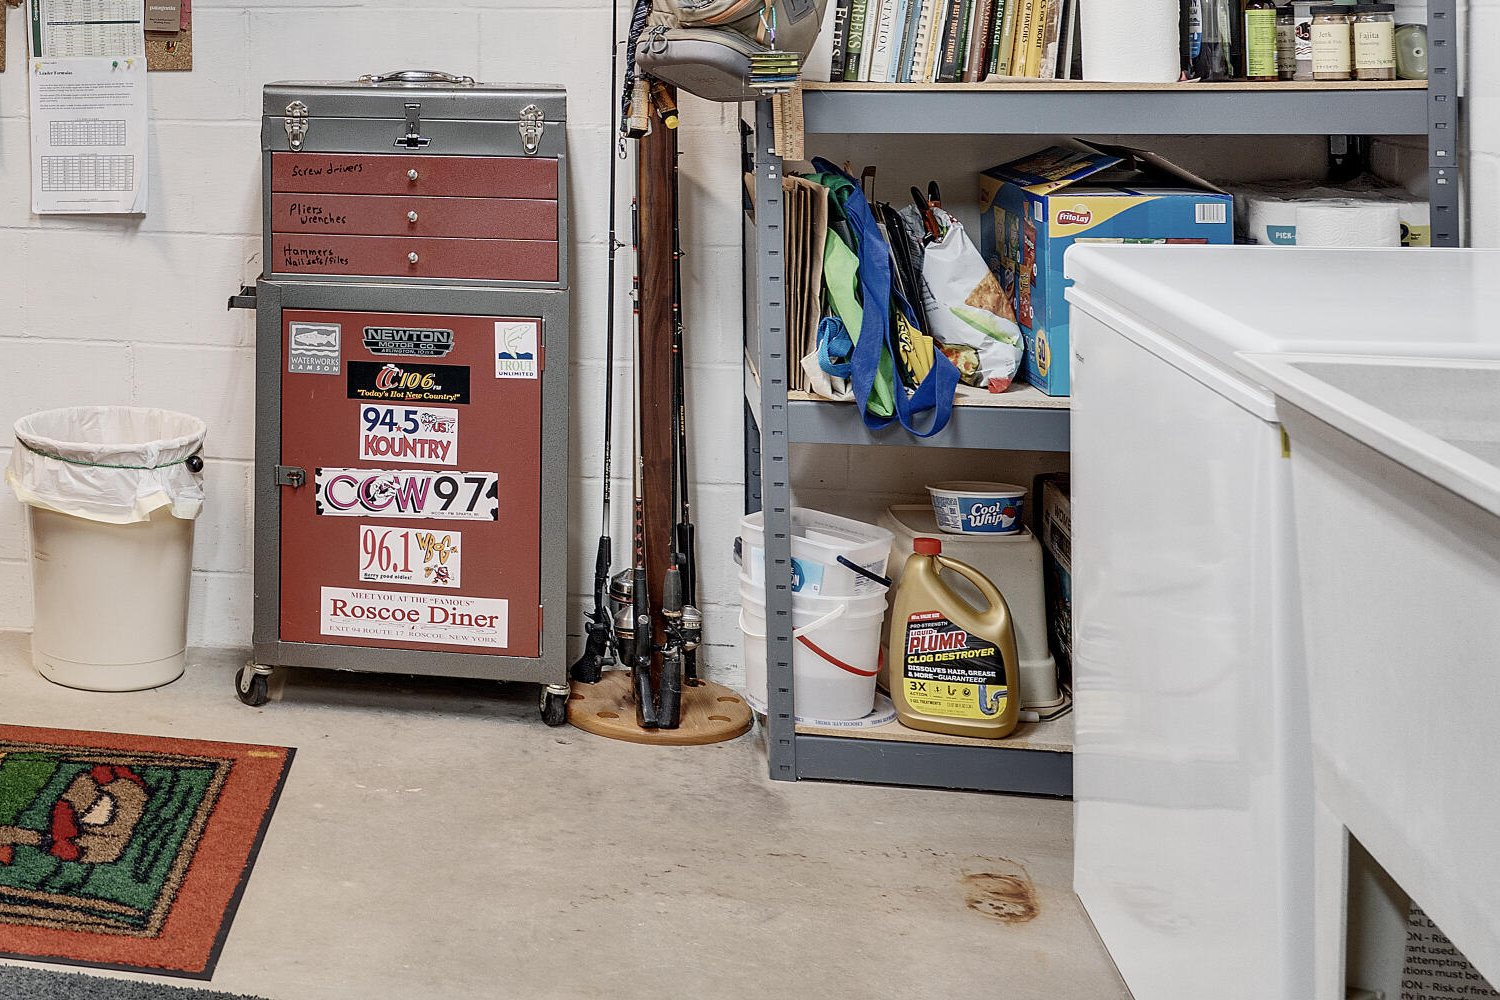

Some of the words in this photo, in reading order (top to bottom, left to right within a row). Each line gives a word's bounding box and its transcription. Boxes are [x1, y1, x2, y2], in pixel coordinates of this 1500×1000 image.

[952, 4, 961, 18] BEST
[997, 7, 1004, 18] TO
[1025, 2, 1032, 11] OF
[831, 6, 848, 57] FLIES
[949, 19, 959, 37] TROUT
[993, 19, 1002, 45] MATCH
[1021, 13, 1031, 43] HATCHES
[1035, 24, 1044, 49] TROUT
[1359, 32, 1379, 40] Fajita
[946, 38, 956, 64] STREAMS
[292, 165, 322, 177] Screw
[327, 163, 363, 175] drivers
[290, 203, 322, 216] Pliers
[300, 213, 346, 225] wrenches
[284, 243, 333, 258] Hammers
[285, 256, 304, 266] Nail
[368, 329, 448, 343] NEWTON
[419, 342, 436, 350] CO.
[291, 356, 339, 366] WATERWORKS
[499, 361, 533, 371] TROUT
[357, 388, 389, 399] "Today's
[405, 391, 422, 399] New
[423, 392, 461, 401] Country!"
[363, 434, 452, 462] KOUNTRY
[324, 474, 432, 513] COW
[433, 475, 488, 512] 97
[970, 502, 1000, 516] Cool
[967, 513, 1002, 527] Whip
[361, 529, 413, 573] 96.1
[351, 591, 377, 600] MEET
[377, 593, 396, 602] YOU
[397, 595, 409, 603] AT
[411, 596, 428, 604] THE
[429, 598, 475, 607] "FAMOUS"
[329, 598, 420, 623] Roscoe
[427, 605, 499, 629] Diner
[909, 621, 948, 629] PRO-STRENGTH
[363, 628, 394, 636] ROUTE
[470, 635, 498, 644] YORK
[908, 631, 967, 654] PLUMR
[907, 654, 934, 664] CLOG
[935, 648, 995, 661] DESTROYER
[907, 665, 946, 674] DISSOLVES
[947, 669, 967, 677] HAIR,
[968, 670, 996, 678] GREASE
[909, 681, 927, 692] 3X
[1432, 934, 1451, 943] Ris
[1428, 946, 1457, 956] used.
[1406, 956, 1467, 969] attempting
[1435, 970, 1462, 979] must
[1465, 971, 1479, 980] be
[1432, 983, 1455, 993] Risk
[1456, 985, 1469, 994] of
[1470, 985, 1488, 996] fire
